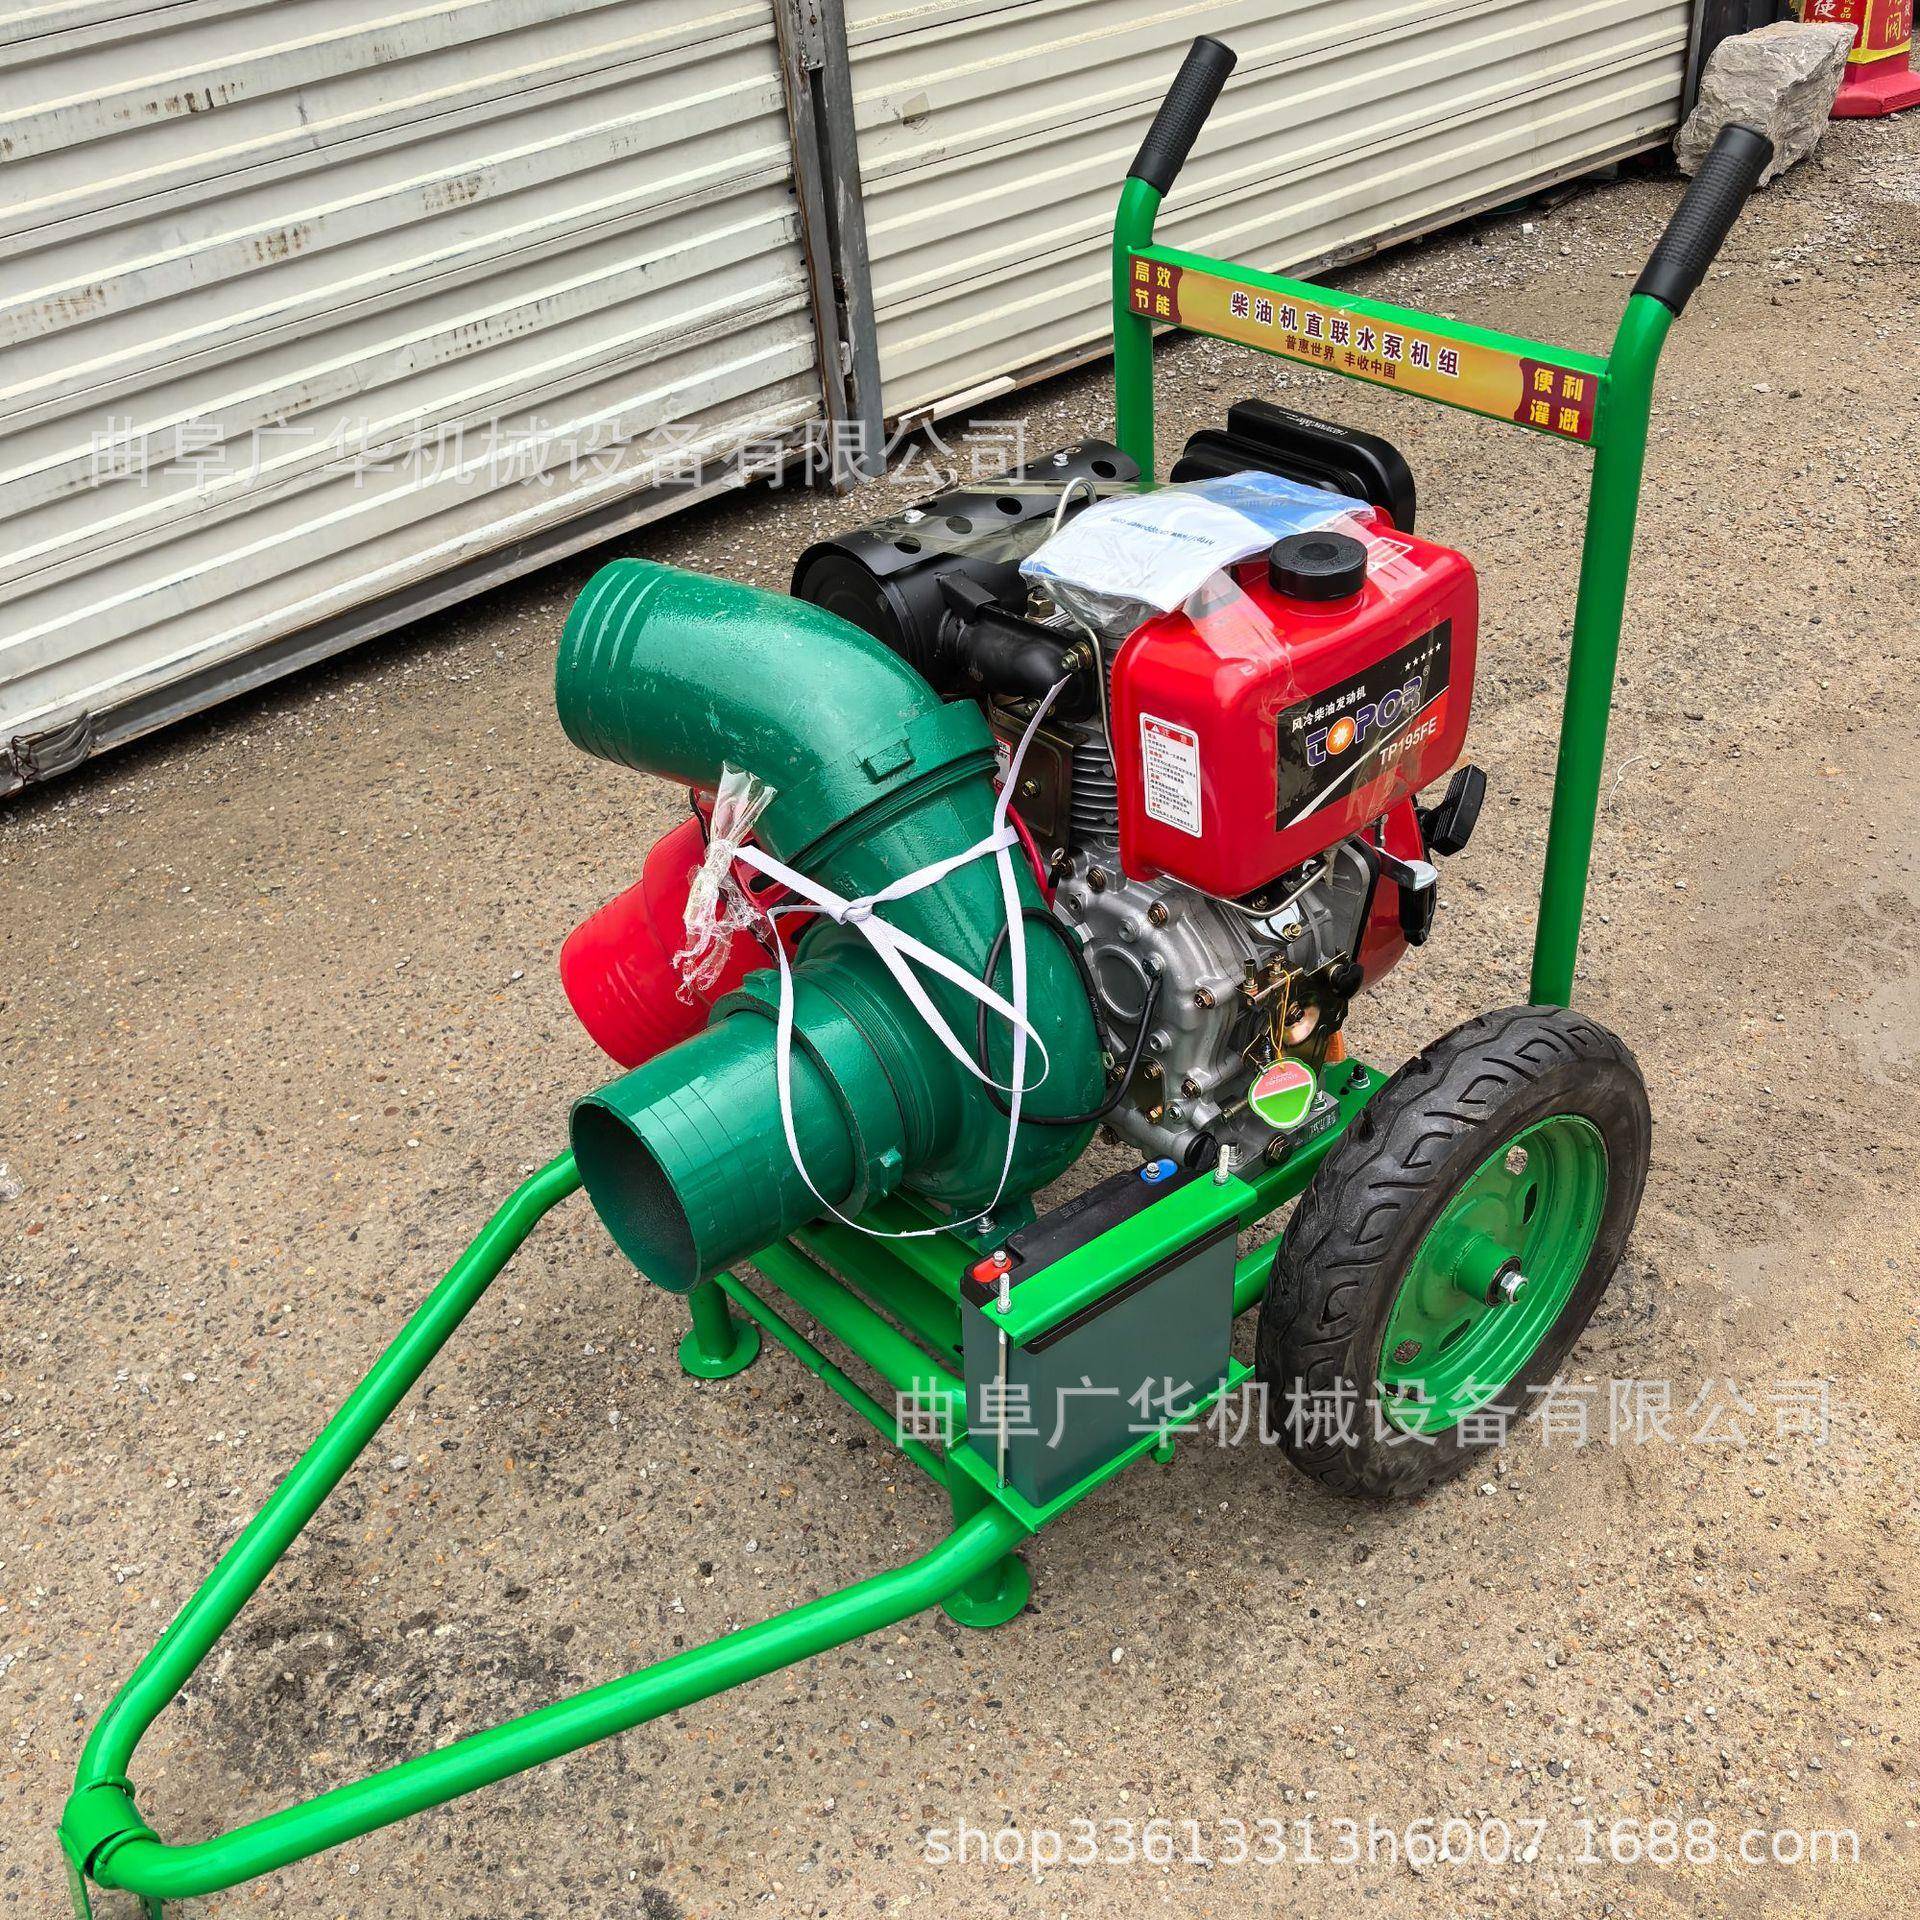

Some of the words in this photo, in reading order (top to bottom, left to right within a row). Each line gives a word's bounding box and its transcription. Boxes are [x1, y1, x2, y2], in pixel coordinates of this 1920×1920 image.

[1135, 260, 1171, 289] 高效
[1135, 288, 1170, 317] 节能
[1231, 292, 1459, 377] 柴油机直联水泵机组
[1285, 334, 1335, 362] 普惠世界
[1344, 351, 1396, 379] 丰收中国
[1533, 367, 1584, 402] 便利
[1529, 399, 1580, 433] 灌溉
[1291, 685, 1367, 733] 风冷柴油发动机
[1379, 715, 1439, 766] TP195FE
